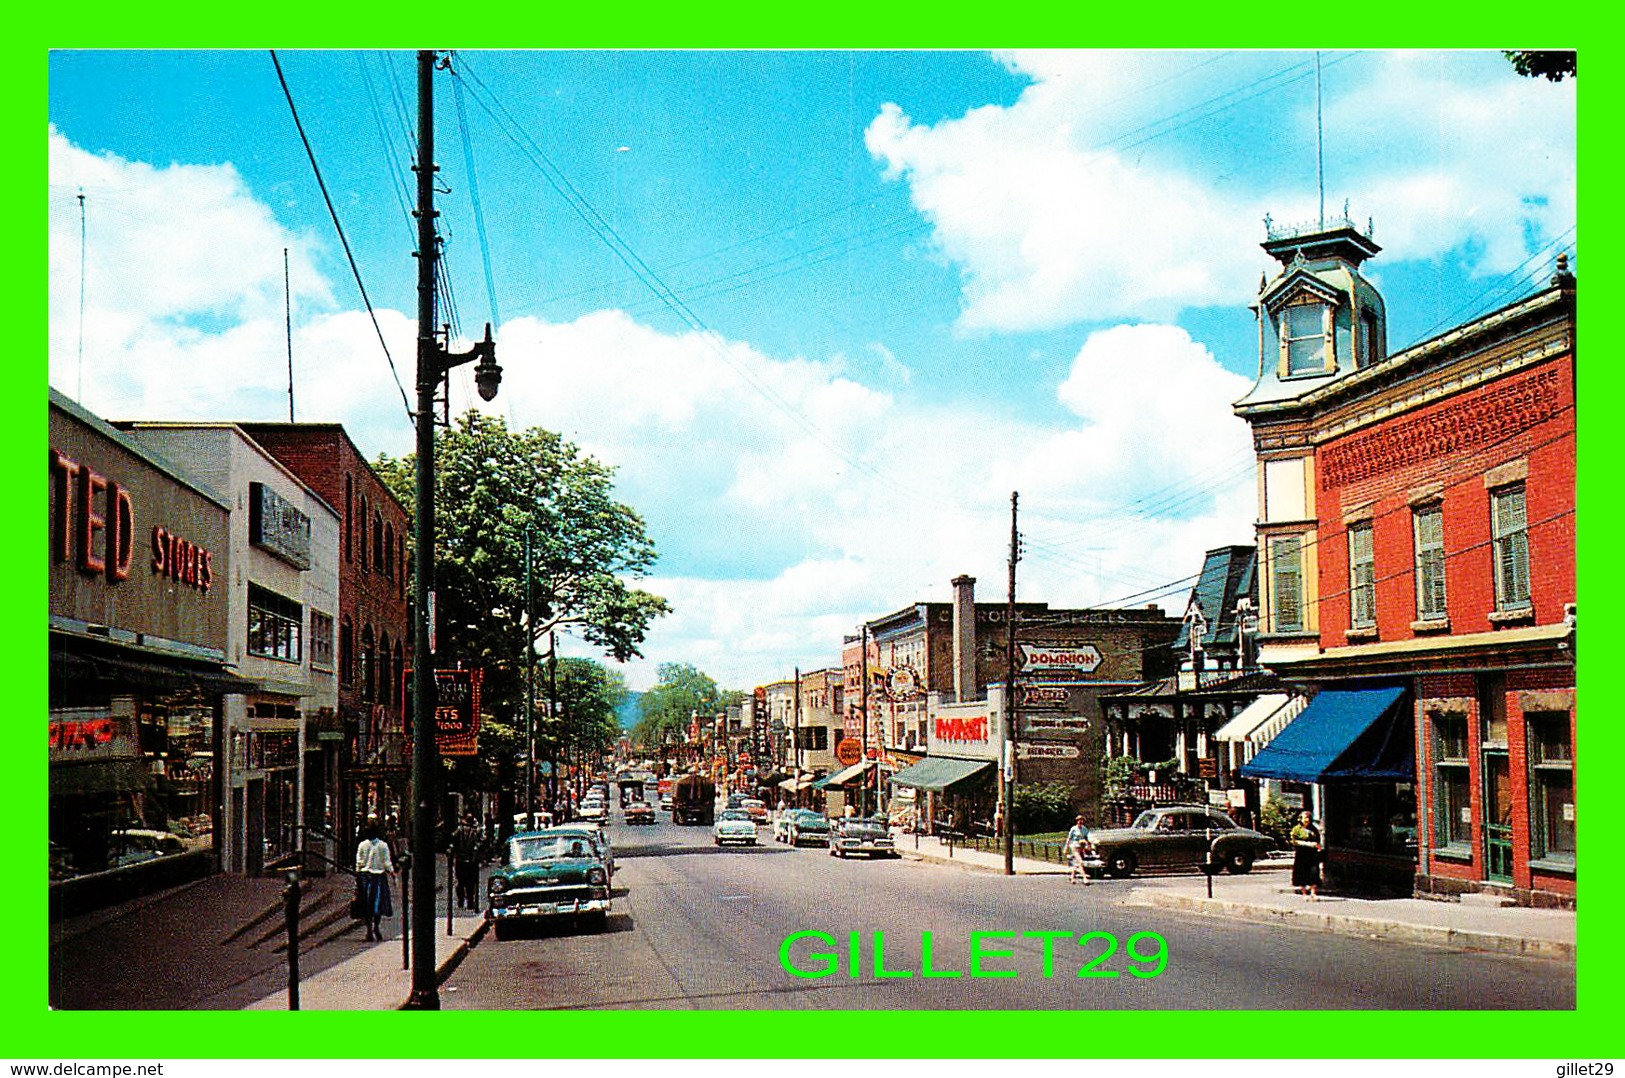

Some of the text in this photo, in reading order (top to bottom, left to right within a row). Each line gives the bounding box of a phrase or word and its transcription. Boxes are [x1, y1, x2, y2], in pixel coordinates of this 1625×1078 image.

[50, 448, 213, 593] TED STORES
[1029, 653, 1095, 664] DOMINION
